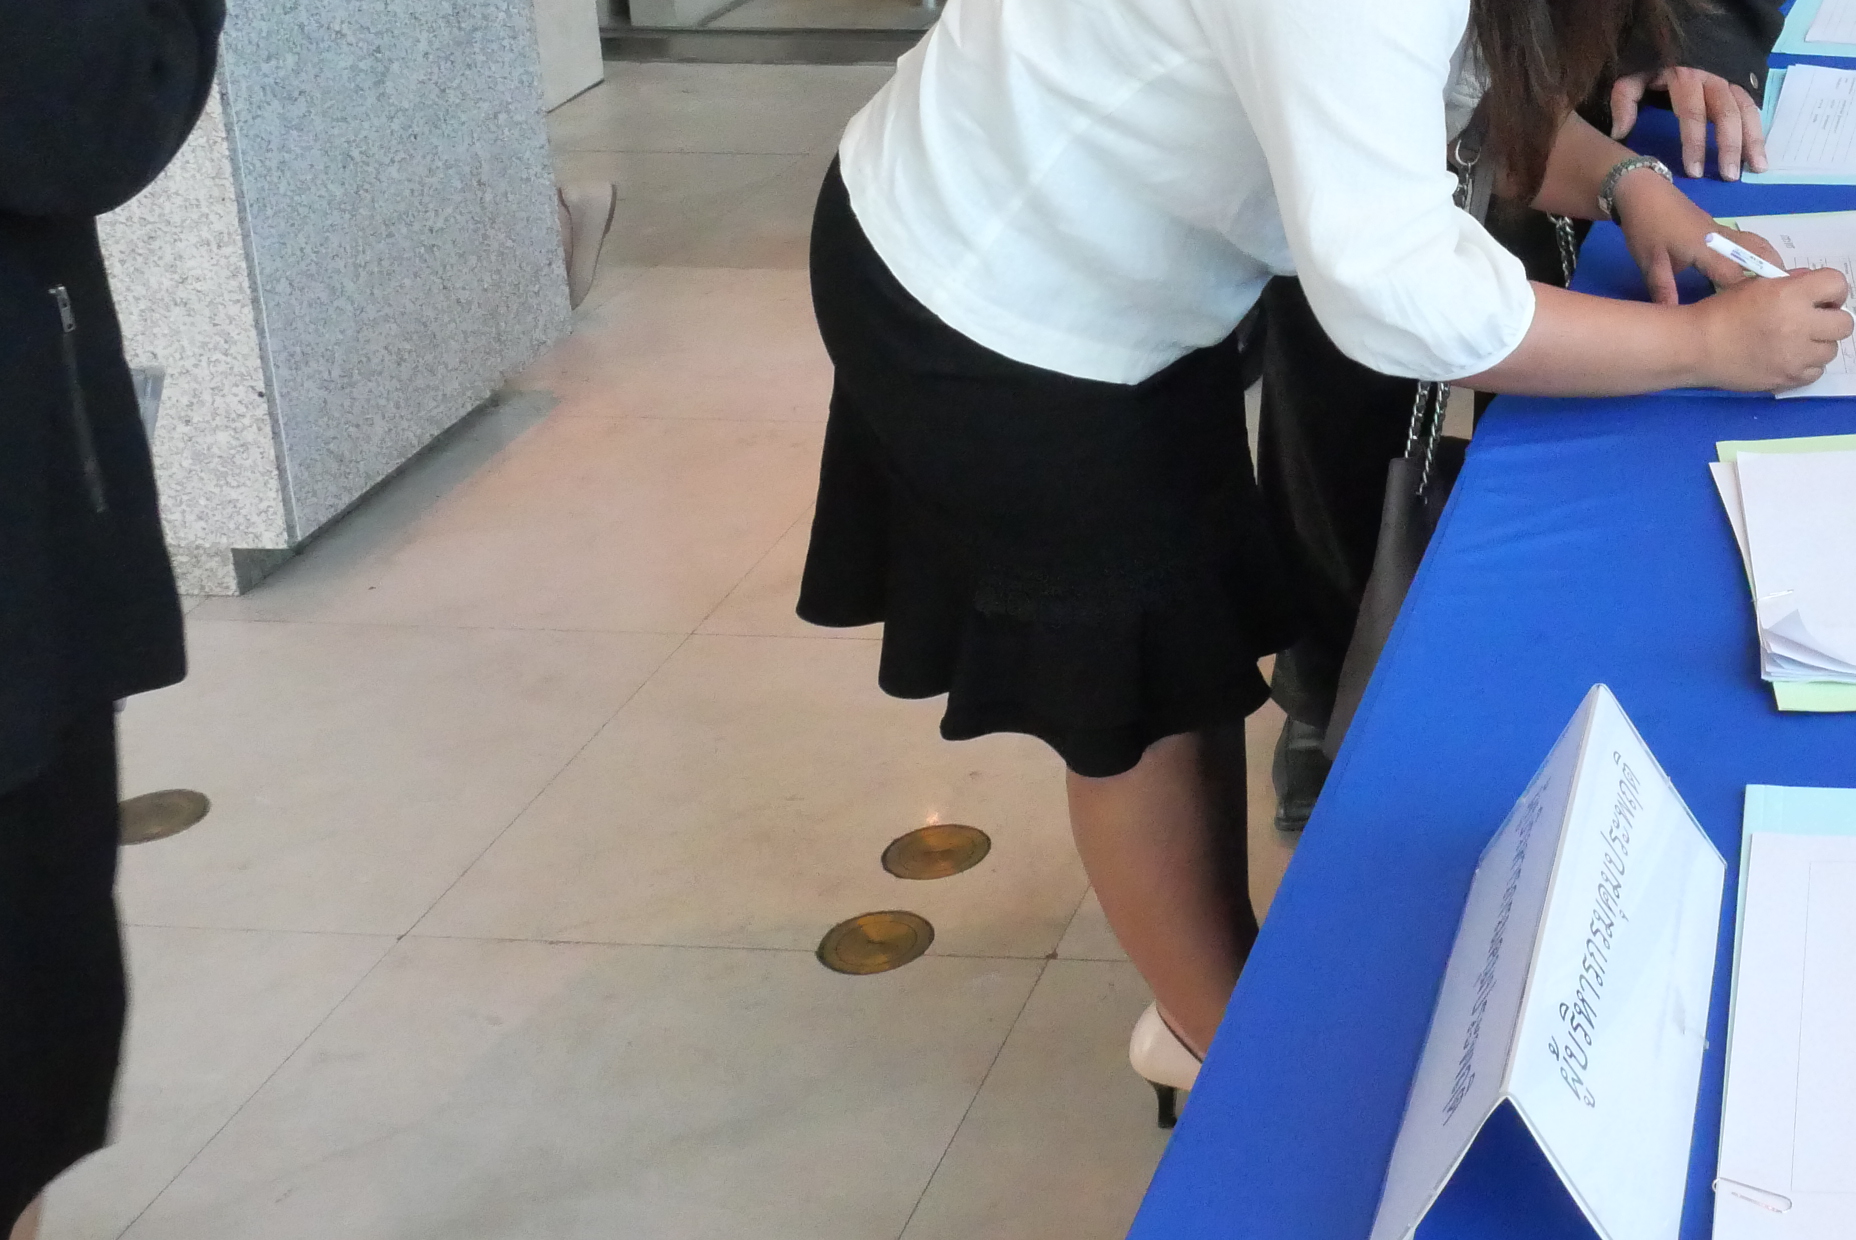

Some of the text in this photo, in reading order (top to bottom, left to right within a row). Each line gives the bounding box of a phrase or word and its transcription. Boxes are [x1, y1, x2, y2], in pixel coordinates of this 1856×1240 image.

[1548, 750, 1641, 1109] ผู้บริหารกรมคุมประพฤติ
